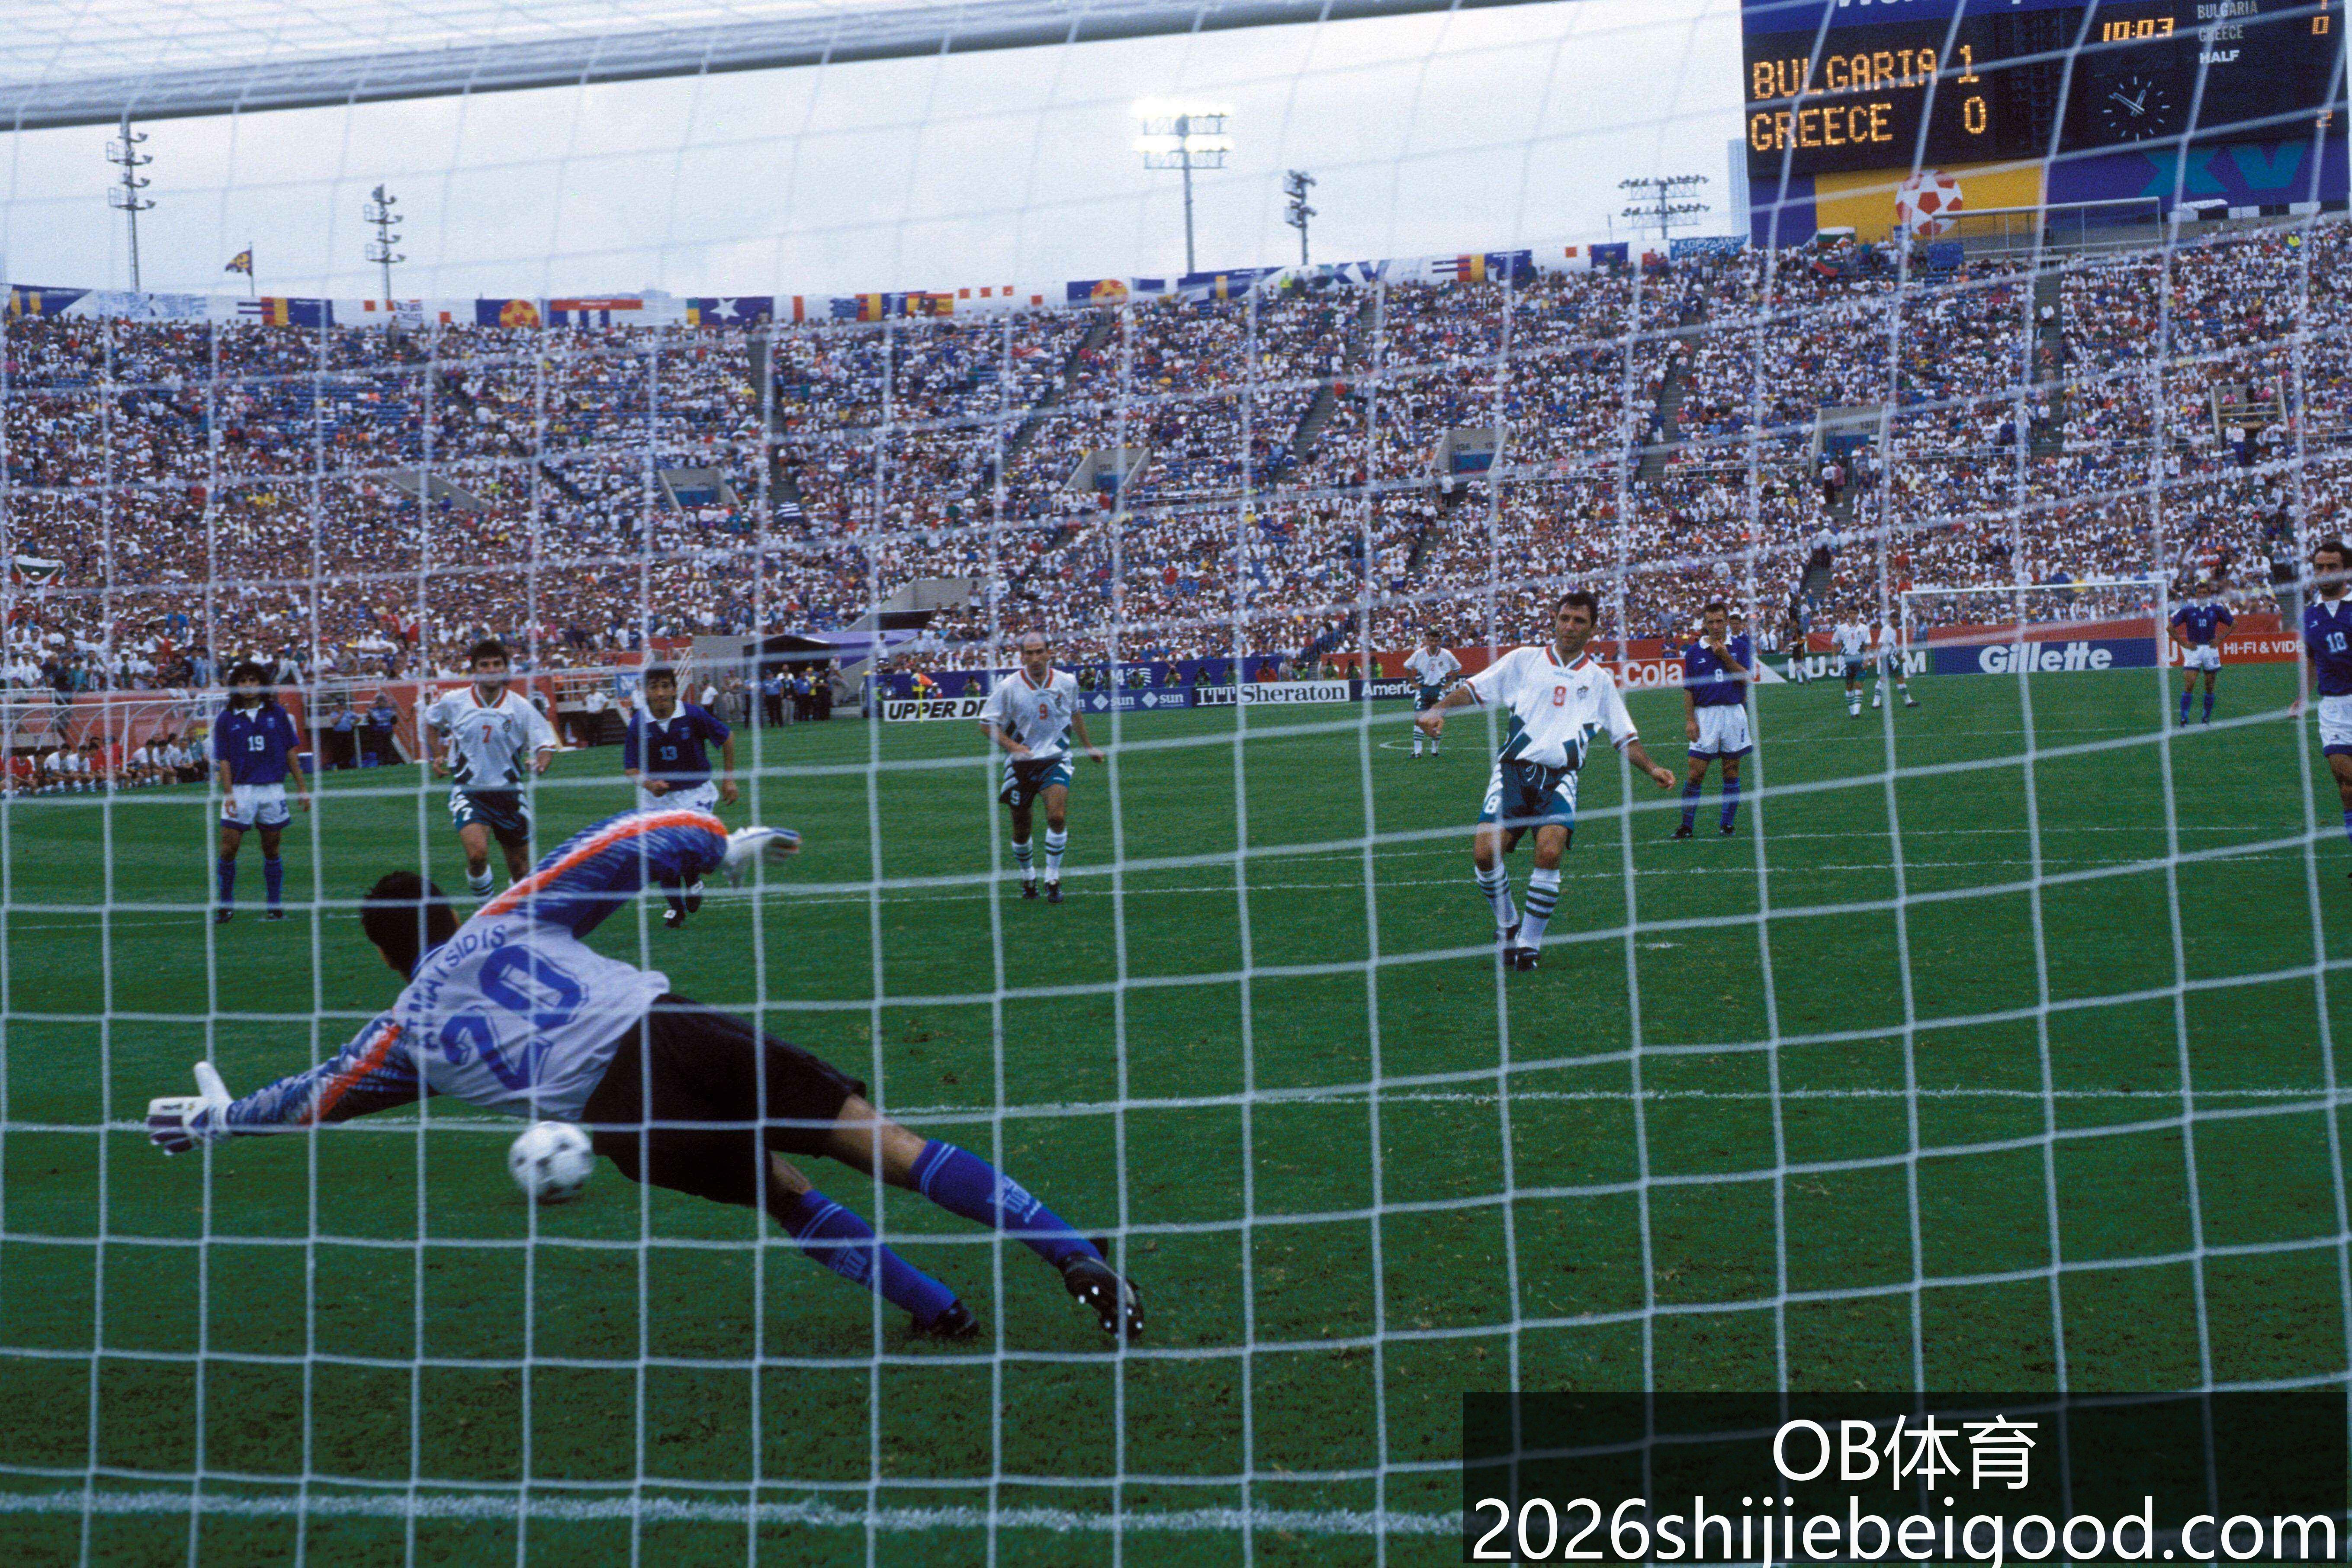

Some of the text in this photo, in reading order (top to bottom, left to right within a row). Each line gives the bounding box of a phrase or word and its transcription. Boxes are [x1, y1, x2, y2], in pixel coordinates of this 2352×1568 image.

[2197, 1, 2258, 19] BULGARIA
[2103, 18, 2174, 42] 10:03
[2312, 16, 2329, 35] 0
[2199, 50, 2240, 64] HALF
[1753, 45, 1979, 99] BULGARIA 1
[1751, 96, 1986, 151] GREECE 0
[2223, 641, 2257, 655] HI-FI
[2259, 641, 2269, 653] &
[2326, 631, 2348, 654] 10
[1979, 642, 2113, 674] Gillette
[1715, 668, 1724, 682] 8
[1112, 694, 1184, 706] sun sun
[1197, 684, 1347, 706] ITT Sheraton
[1553, 686, 1566, 707] 8
[888, 700, 957, 720] UPPER
[1039, 703, 1048, 720] 9
[247, 735, 265, 752] 19
[482, 724, 492, 744] 7
[659, 745, 678, 761] 13
[1010, 789, 1021, 806] 9
[1484, 795, 1498, 814] 8
[461, 807, 473, 821] 7
[439, 944, 590, 1092] 20
